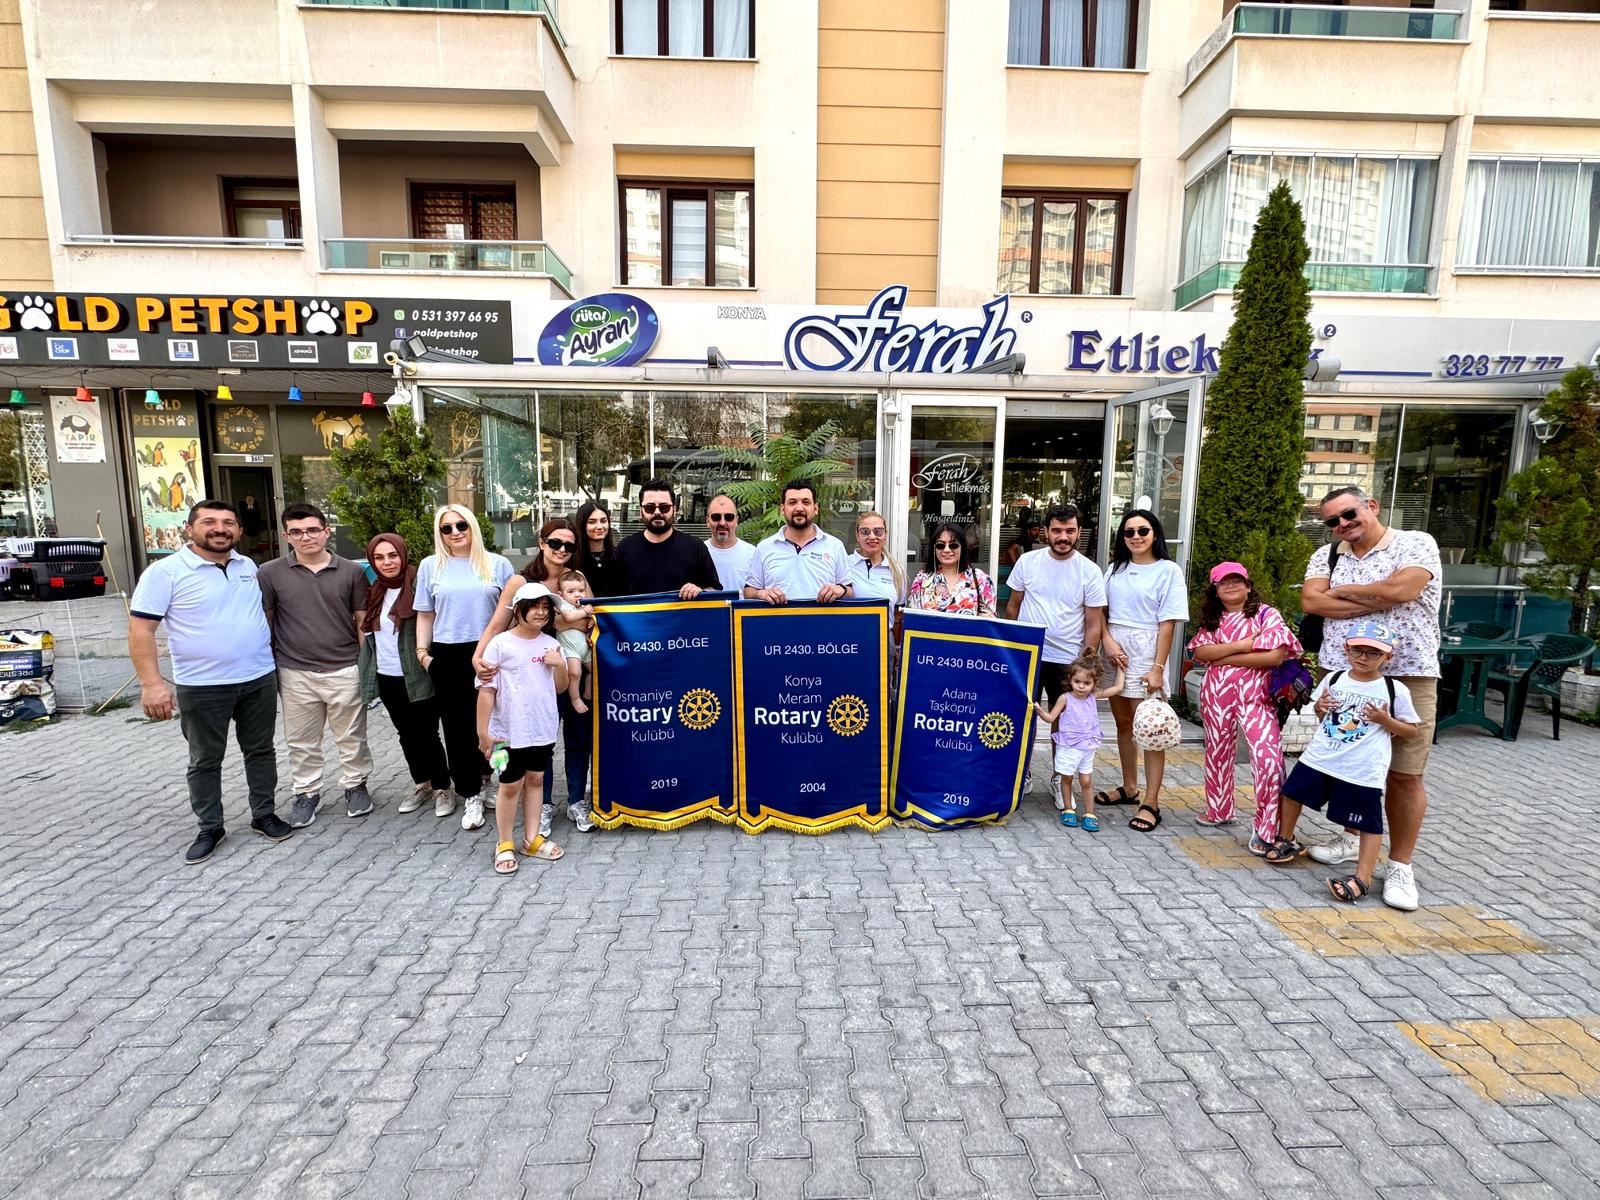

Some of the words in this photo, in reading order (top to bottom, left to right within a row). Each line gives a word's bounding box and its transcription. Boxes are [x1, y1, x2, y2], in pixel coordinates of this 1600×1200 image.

[412, 310, 419, 320] 0
[422, 310, 441, 320] 531
[445, 311, 466, 322] 397
[468, 312, 482, 322] 66
[485, 312, 498, 322] 95
[717, 306, 767, 320] KONYA
[570, 318, 629, 359] Ayran
[1446, 354, 1489, 376] 323
[1498, 355, 1526, 374] 77
[944, 481, 991, 493] Etliekmek
[617, 642, 631, 652] UR
[633, 641, 664, 652] 2430.
[668, 637, 709, 650] BÖLGE
[764, 645, 781, 655] UR
[785, 645, 814, 655] 2430.
[817, 642, 858, 654] BÖLGE
[917, 655, 934, 666] UR
[937, 657, 963, 668] 2430
[966, 659, 1008, 674] BÖLGE
[785, 675, 822, 691] Konya
[611, 689, 673, 705] Osmaniye
[779, 693, 822, 704] Meram
[942, 688, 977, 700] Adana
[606, 703, 673, 723] Rotary
[929, 700, 976, 715] Taşköprü
[754, 707, 822, 727] Rotary
[914, 713, 974, 737] Rotary
[631, 728, 675, 742] Kulübü
[781, 732, 823, 744] Kulübü
[935, 738, 973, 751] Kulübü
[651, 778, 678, 789] 2019
[800, 783, 826, 793] 2004
[943, 793, 970, 806] 2019
